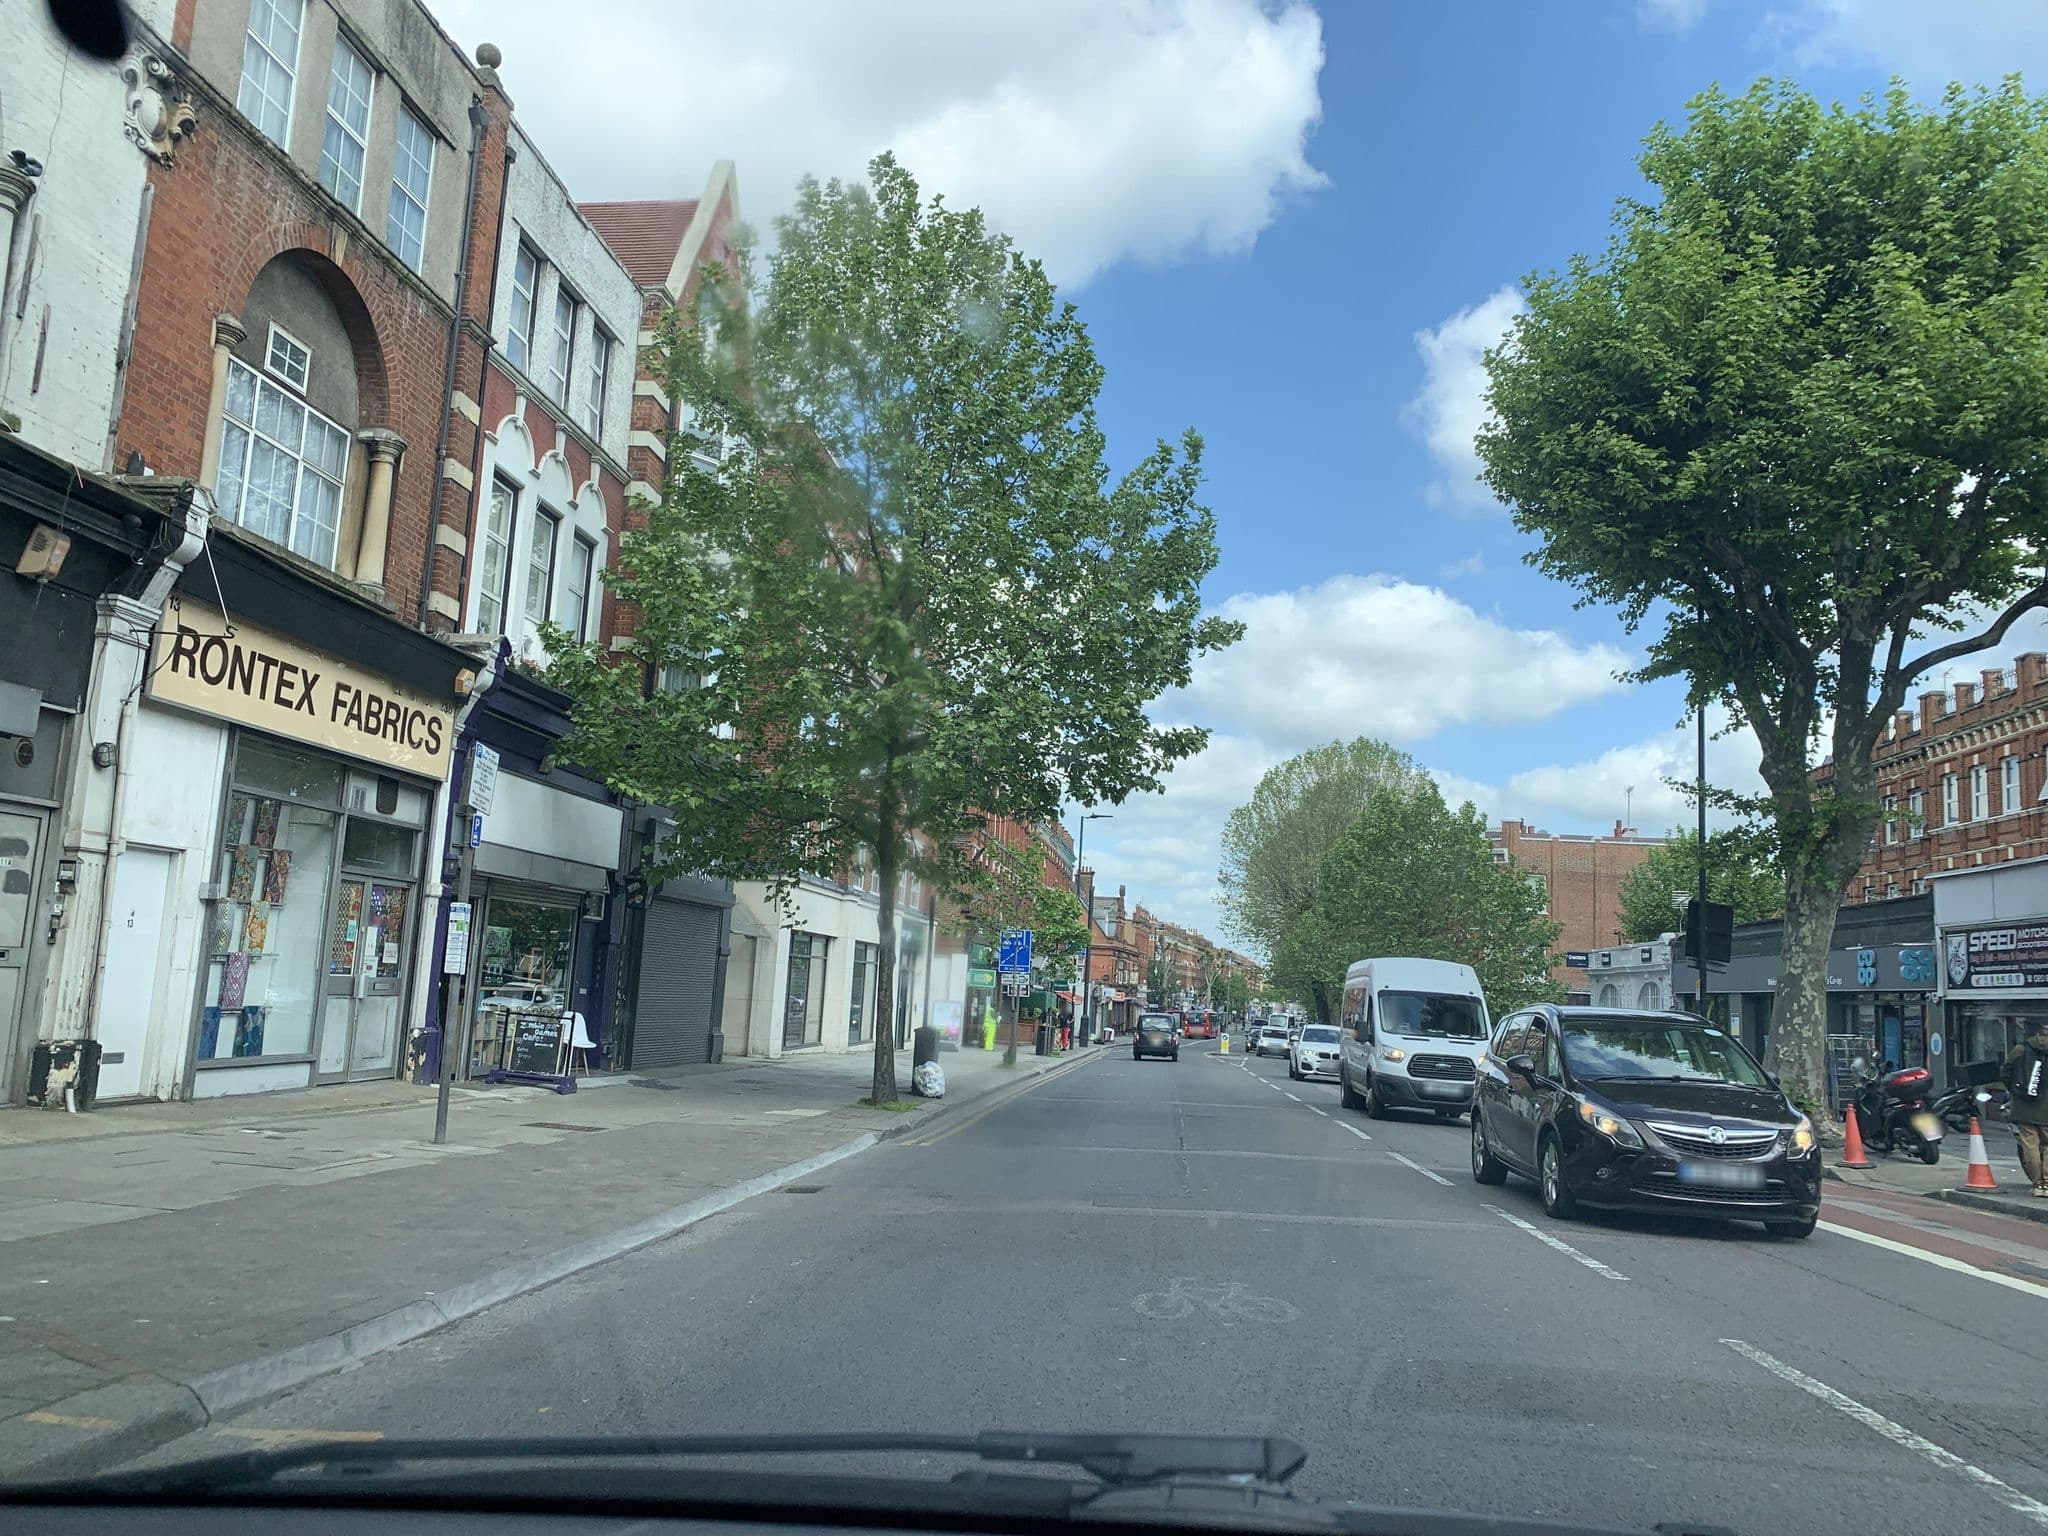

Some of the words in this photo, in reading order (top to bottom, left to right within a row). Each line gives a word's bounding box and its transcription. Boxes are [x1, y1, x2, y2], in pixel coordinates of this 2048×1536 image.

[169, 595, 181, 612] 13
[171, 624, 320, 716] RONTEX
[331, 681, 443, 755] FABRICS
[127, 918, 133, 928] 13
[1970, 930, 2017, 951] SPEED
[535, 1029, 558, 1037] Games
